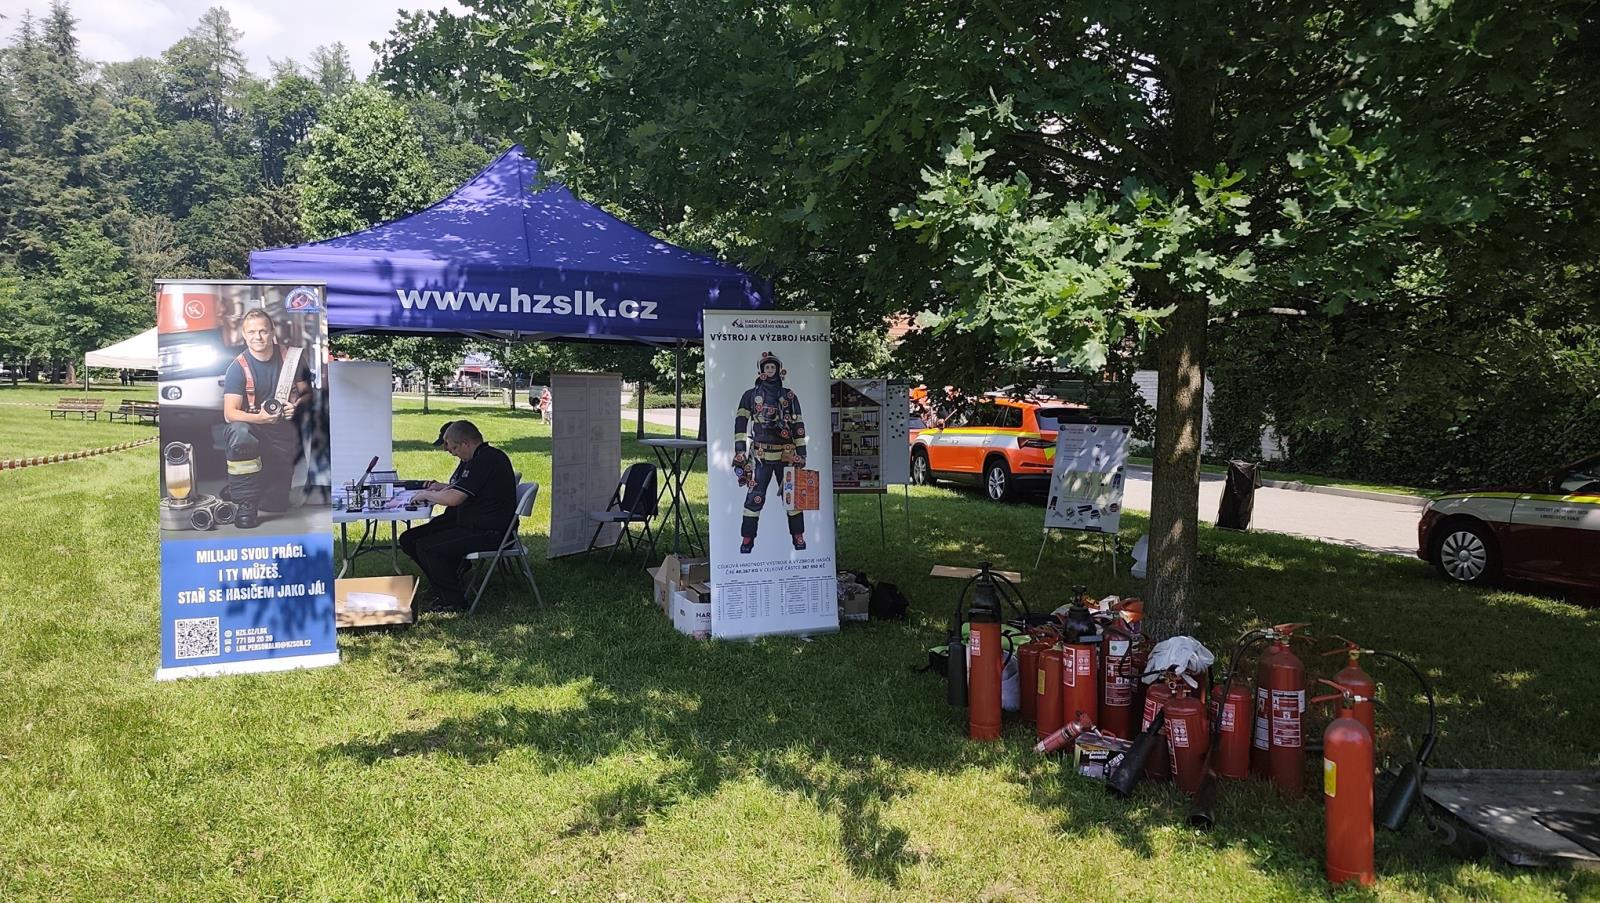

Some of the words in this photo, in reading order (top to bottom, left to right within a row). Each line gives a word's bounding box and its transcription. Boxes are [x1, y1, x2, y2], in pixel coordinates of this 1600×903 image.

[396, 287, 658, 319] www.hzslk.cz
[710, 332, 748, 341] VÝSTROJ
[760, 332, 798, 342] VÝZBROJ
[800, 333, 830, 342] HASIČE
[196, 548, 238, 564] MILUJU
[240, 547, 269, 561] SVOU
[272, 544, 306, 559] PRÁCI.
[218, 570, 222, 582] I
[226, 568, 238, 581] TY
[242, 562, 282, 580] MŮŽEŠ.
[178, 587, 206, 604] STAŇ
[208, 589, 222, 602] SE
[226, 583, 274, 600] HASIČEM
[277, 584, 304, 598] JAKO
[308, 580, 326, 595] JÁ!
